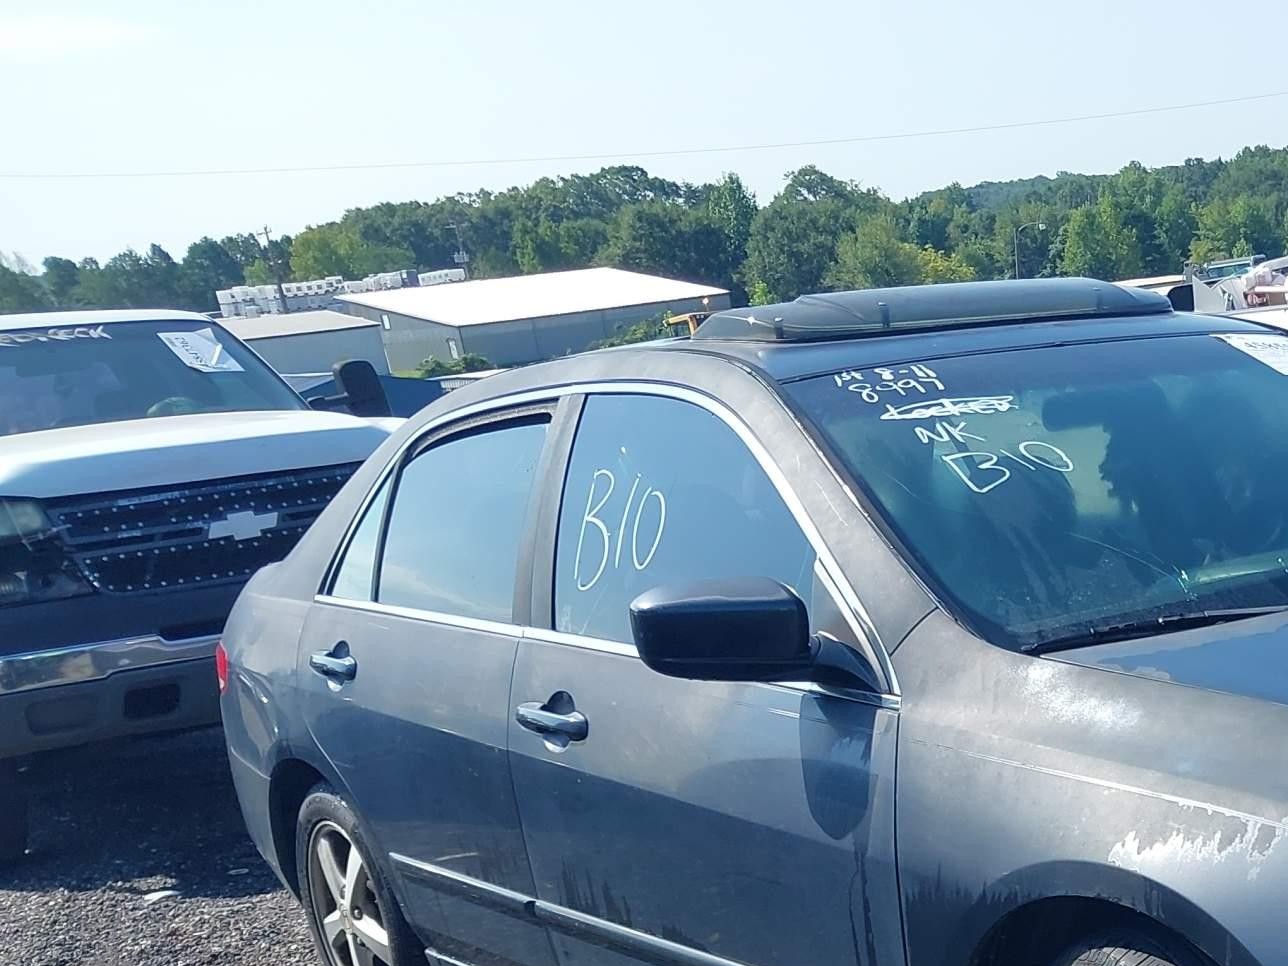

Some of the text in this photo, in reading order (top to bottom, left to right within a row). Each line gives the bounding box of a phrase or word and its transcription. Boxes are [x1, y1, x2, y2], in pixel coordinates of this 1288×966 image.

[848, 378, 946, 404] 8997
[914, 421, 985, 443] NK
[941, 441, 1074, 493] B10
[573, 468, 667, 591] B10
